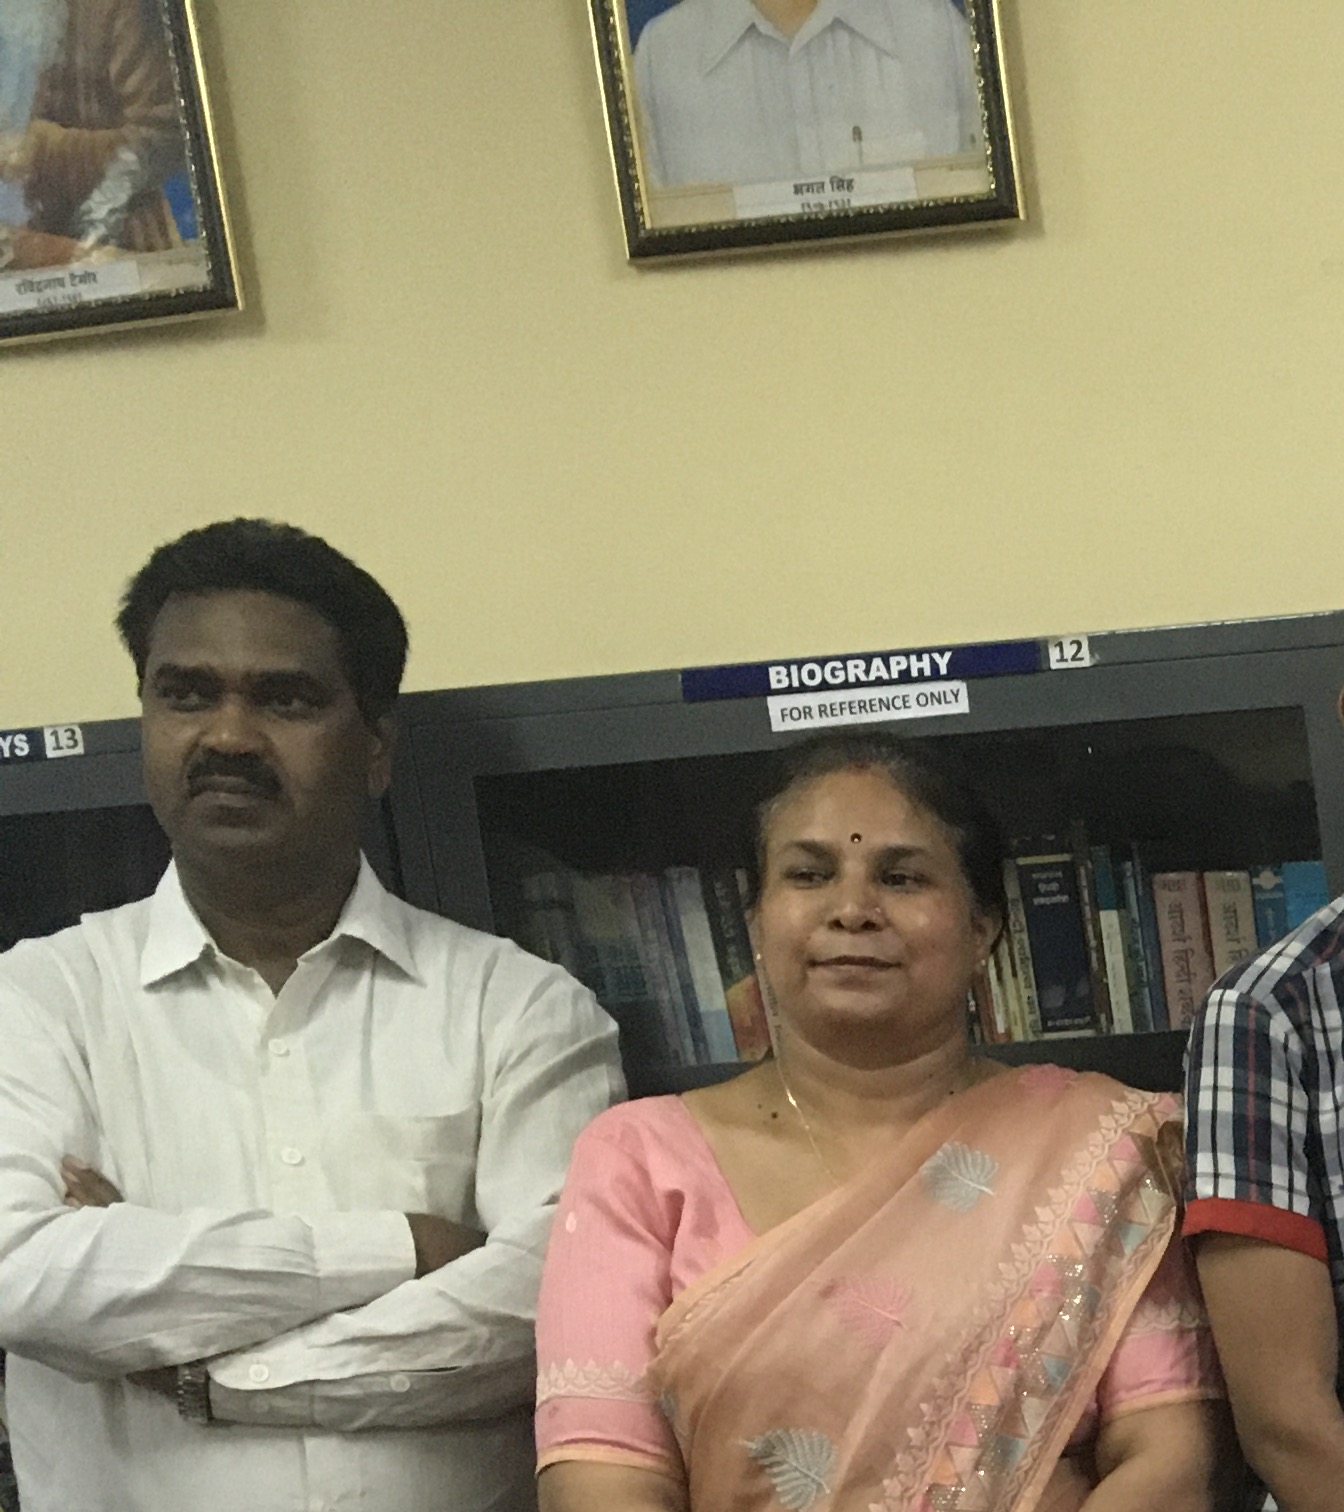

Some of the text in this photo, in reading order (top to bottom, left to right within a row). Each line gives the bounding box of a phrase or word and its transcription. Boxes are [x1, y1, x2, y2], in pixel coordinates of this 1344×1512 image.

[768, 639, 1085, 690] BIOGRAPHY 12
[780, 687, 962, 723] FOR REFERENCE ONLY
[50, 727, 79, 751] 13
